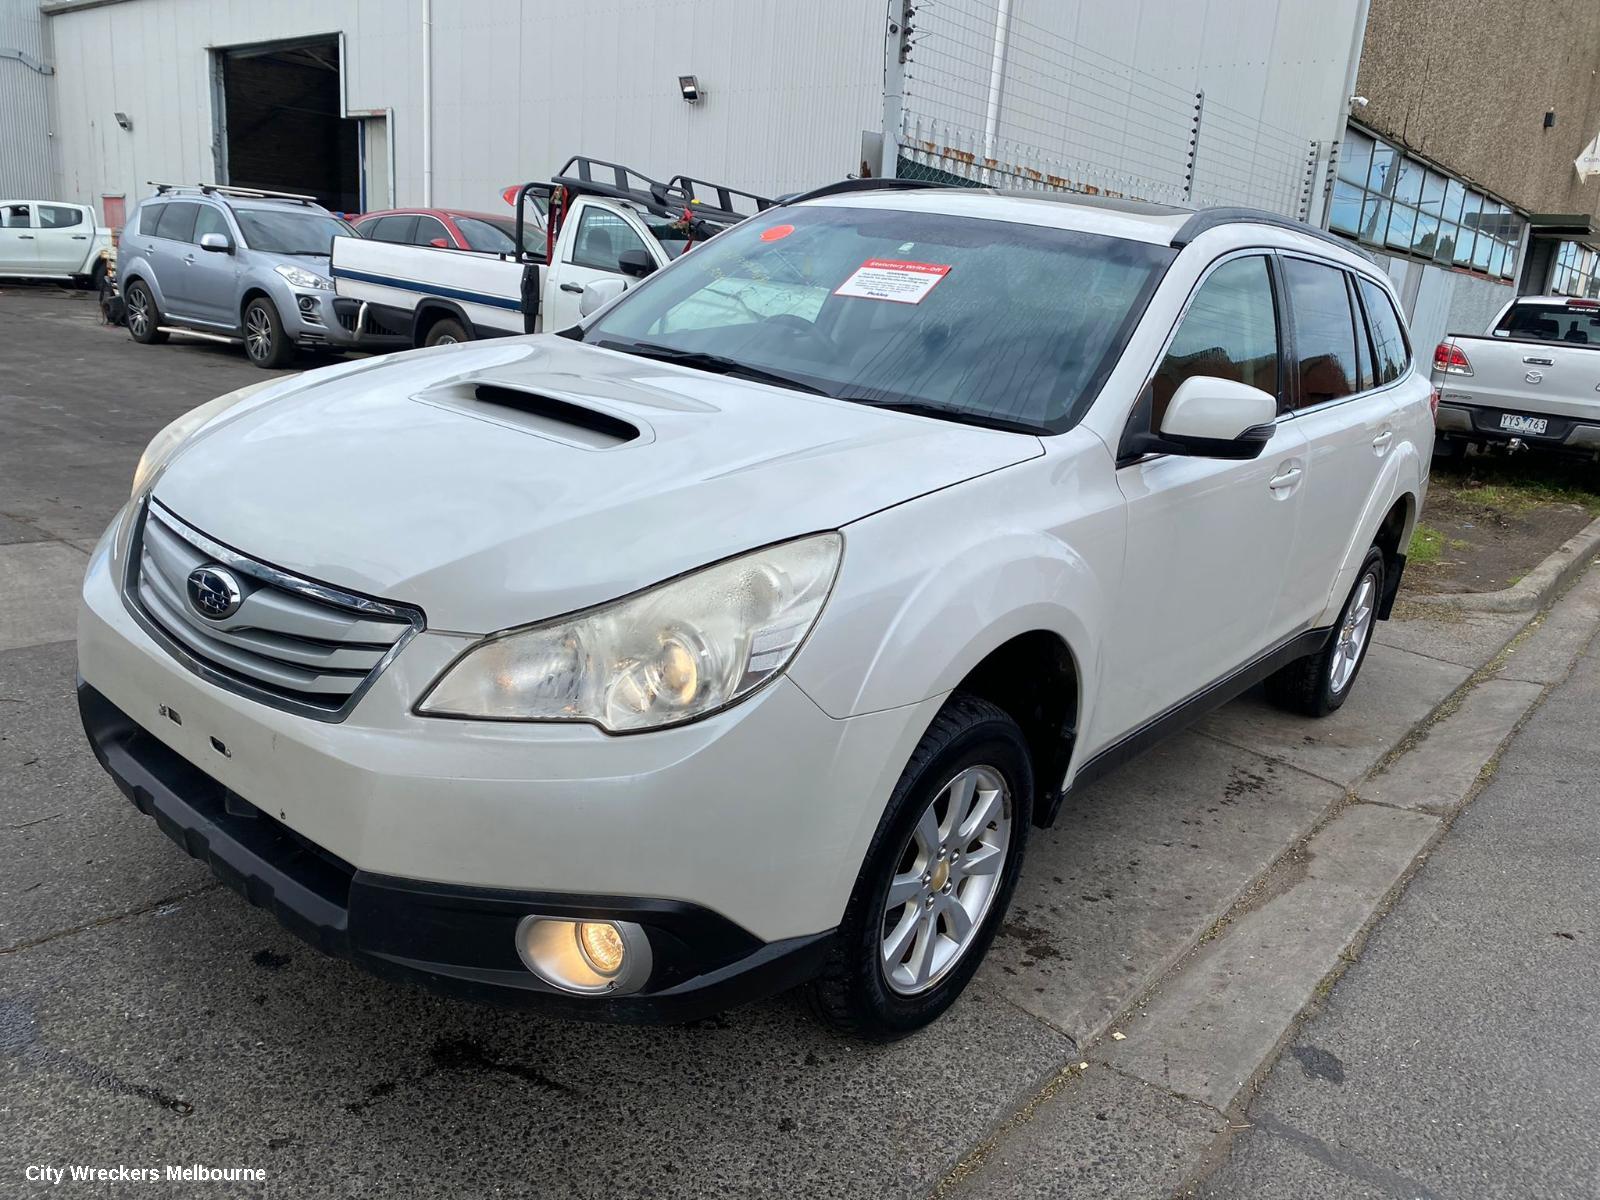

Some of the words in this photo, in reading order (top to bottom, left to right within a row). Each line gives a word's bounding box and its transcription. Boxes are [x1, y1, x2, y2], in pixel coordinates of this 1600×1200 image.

[870, 261, 905, 269] Statutory
[905, 265, 943, 273] Write-Off
[1502, 415, 1521, 427] YYS
[1528, 418, 1546, 430] 763
